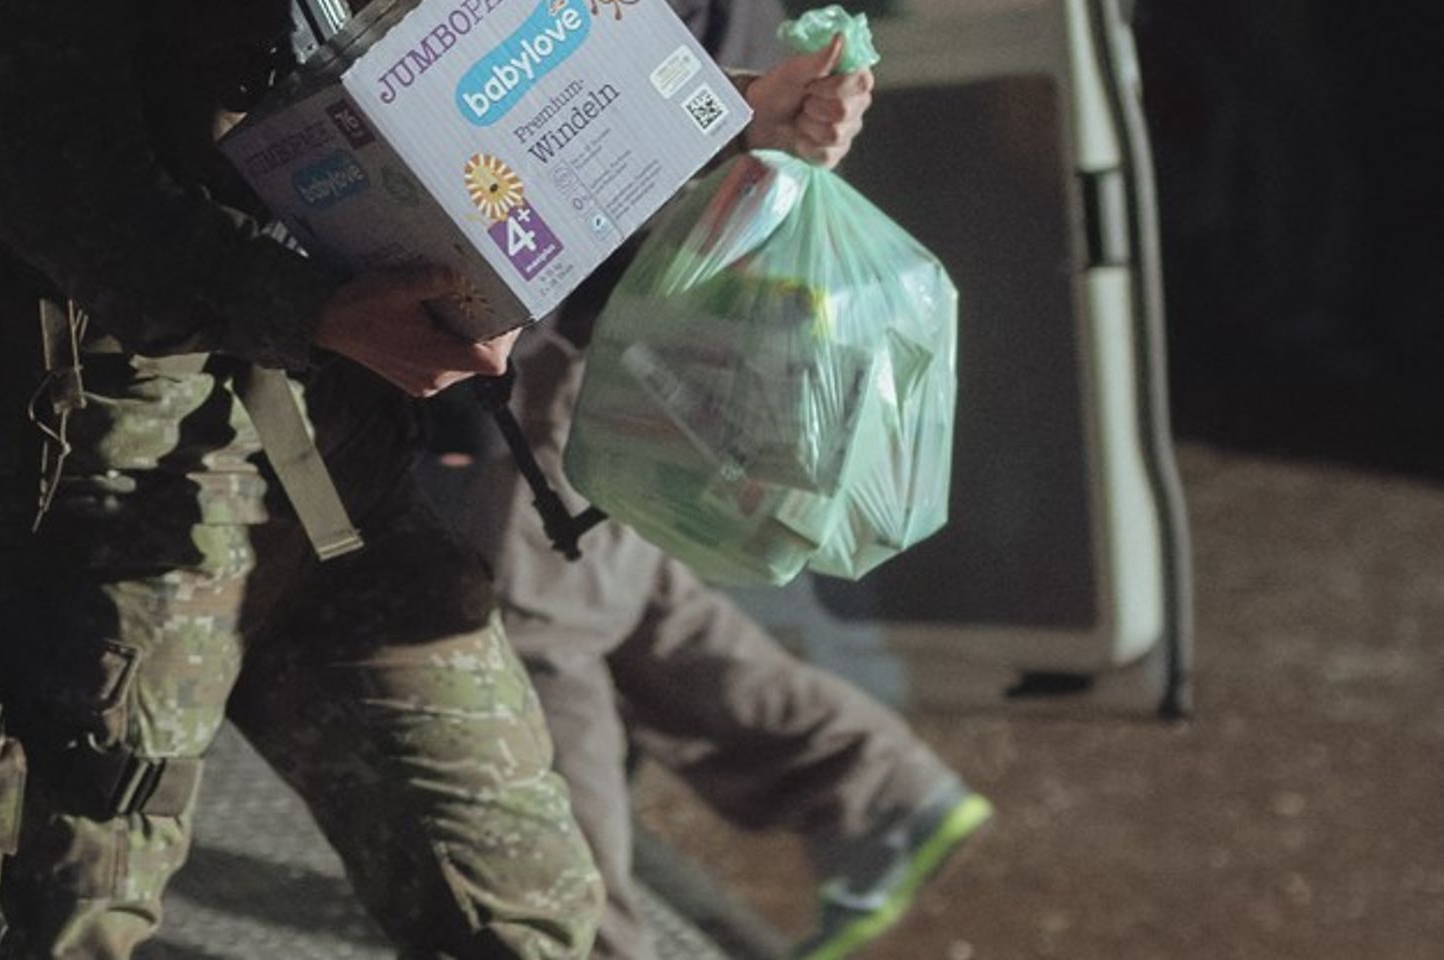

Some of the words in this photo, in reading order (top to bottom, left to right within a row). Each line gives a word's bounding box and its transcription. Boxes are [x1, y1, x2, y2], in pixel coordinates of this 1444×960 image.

[463, 7, 582, 118] babylove
[513, 76, 586, 144] Premium-
[527, 81, 620, 165] Windeln
